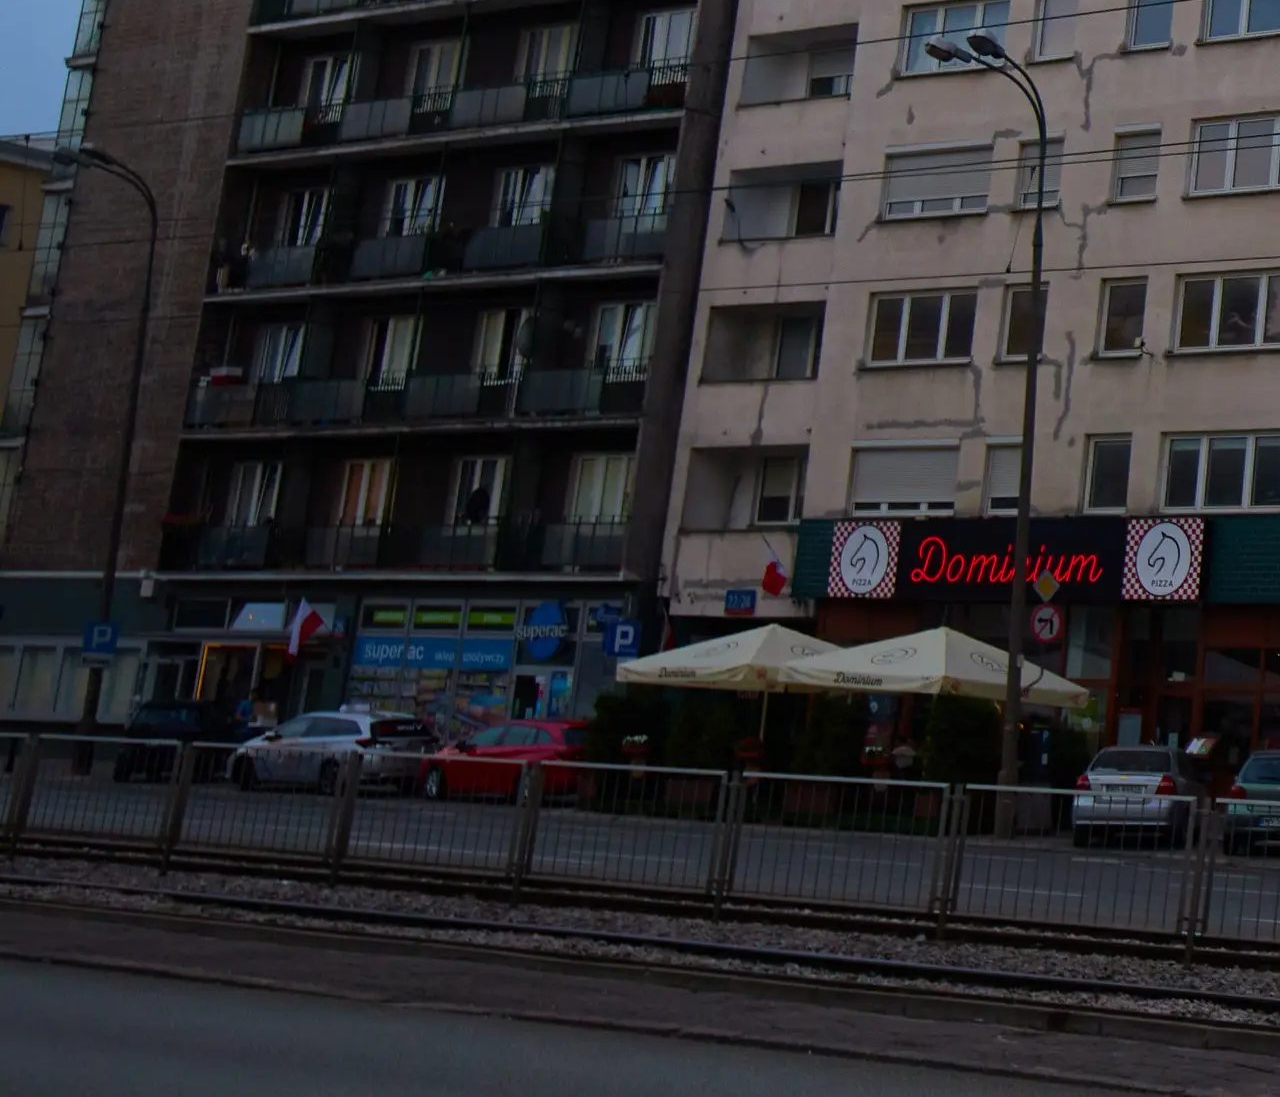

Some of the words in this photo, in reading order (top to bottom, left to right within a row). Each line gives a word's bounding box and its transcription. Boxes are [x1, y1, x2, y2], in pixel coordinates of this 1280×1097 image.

[852, 578, 872, 587] PIZZA
[1151, 579, 1174, 588] PIZZA
[92, 625, 112, 649] P
[614, 624, 635, 654] P
[834, 671, 883, 687] Dominium
